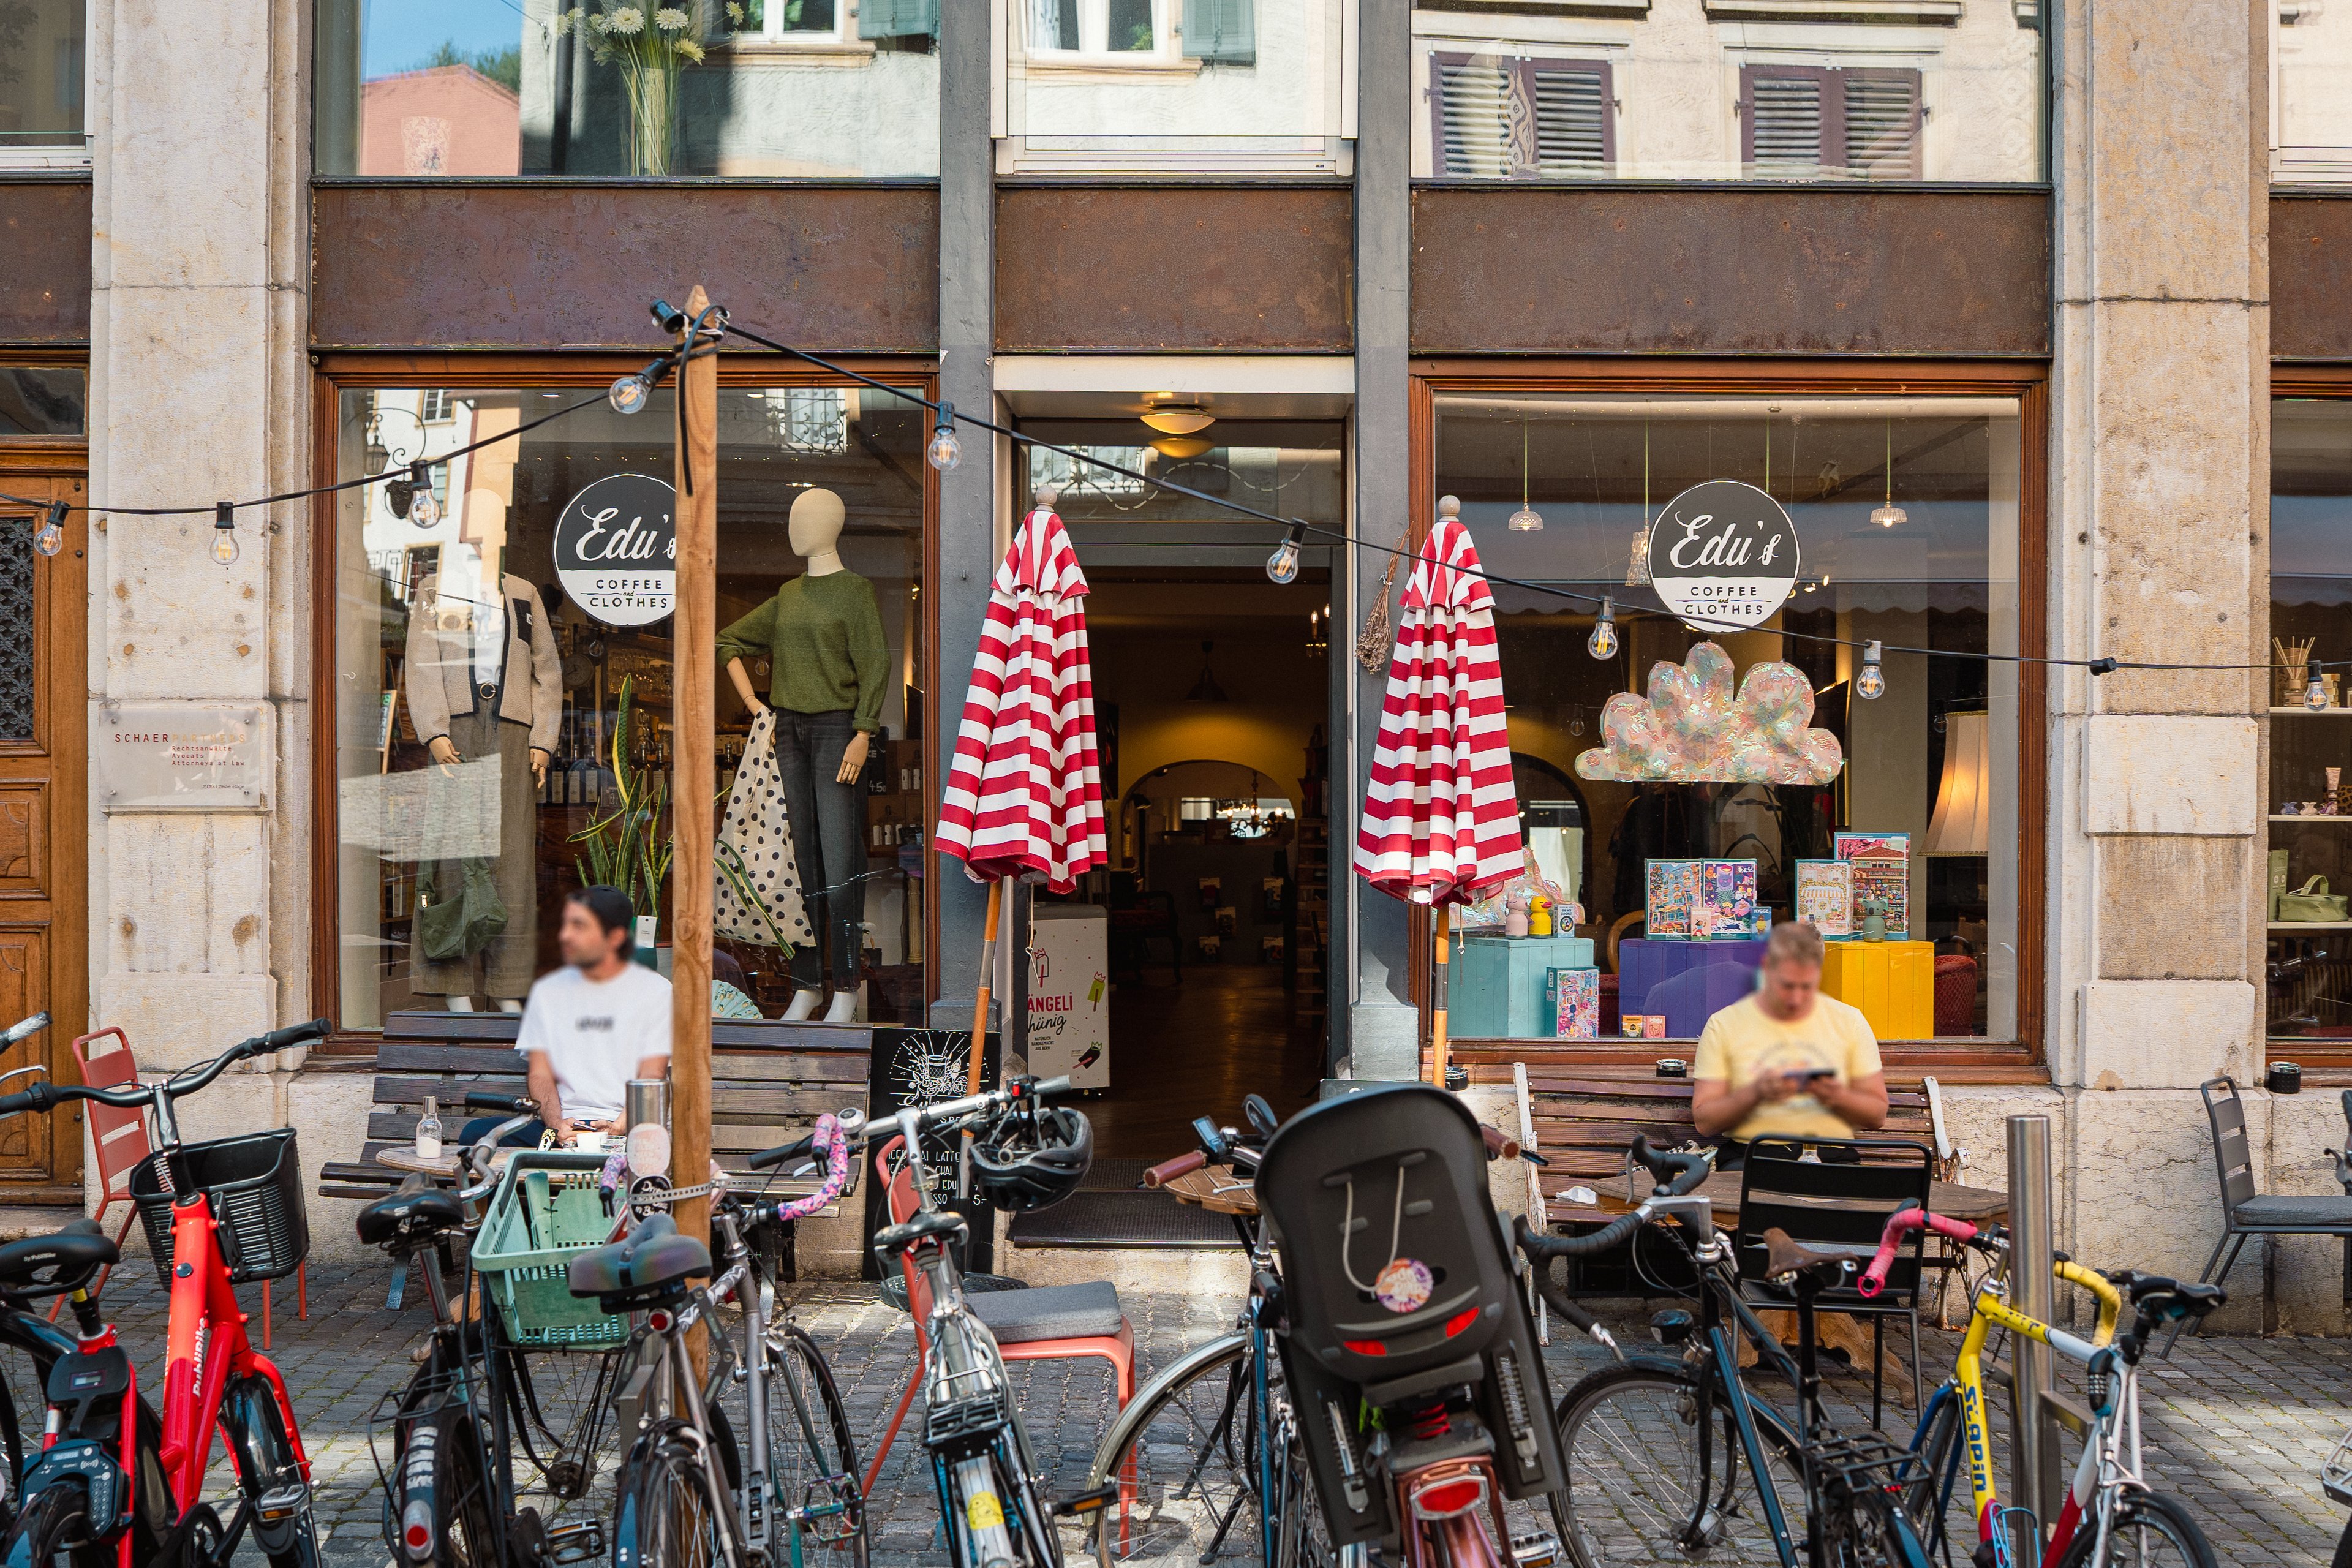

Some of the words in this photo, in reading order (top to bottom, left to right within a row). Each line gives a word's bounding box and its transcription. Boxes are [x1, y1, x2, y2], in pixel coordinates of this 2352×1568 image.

[1670, 511, 1782, 569] Edu's
[596, 579, 662, 590] COFFEE
[1691, 586, 1758, 597] COFFEE
[590, 597, 668, 609] CLOTHES
[1684, 605, 1763, 616] CLOTHES
[1028, 992, 1073, 1012] ÄNGELI
[1028, 1014, 1067, 1035] hünig
[935, 1151, 961, 1163] LATTE
[942, 1180, 957, 1191] EDU
